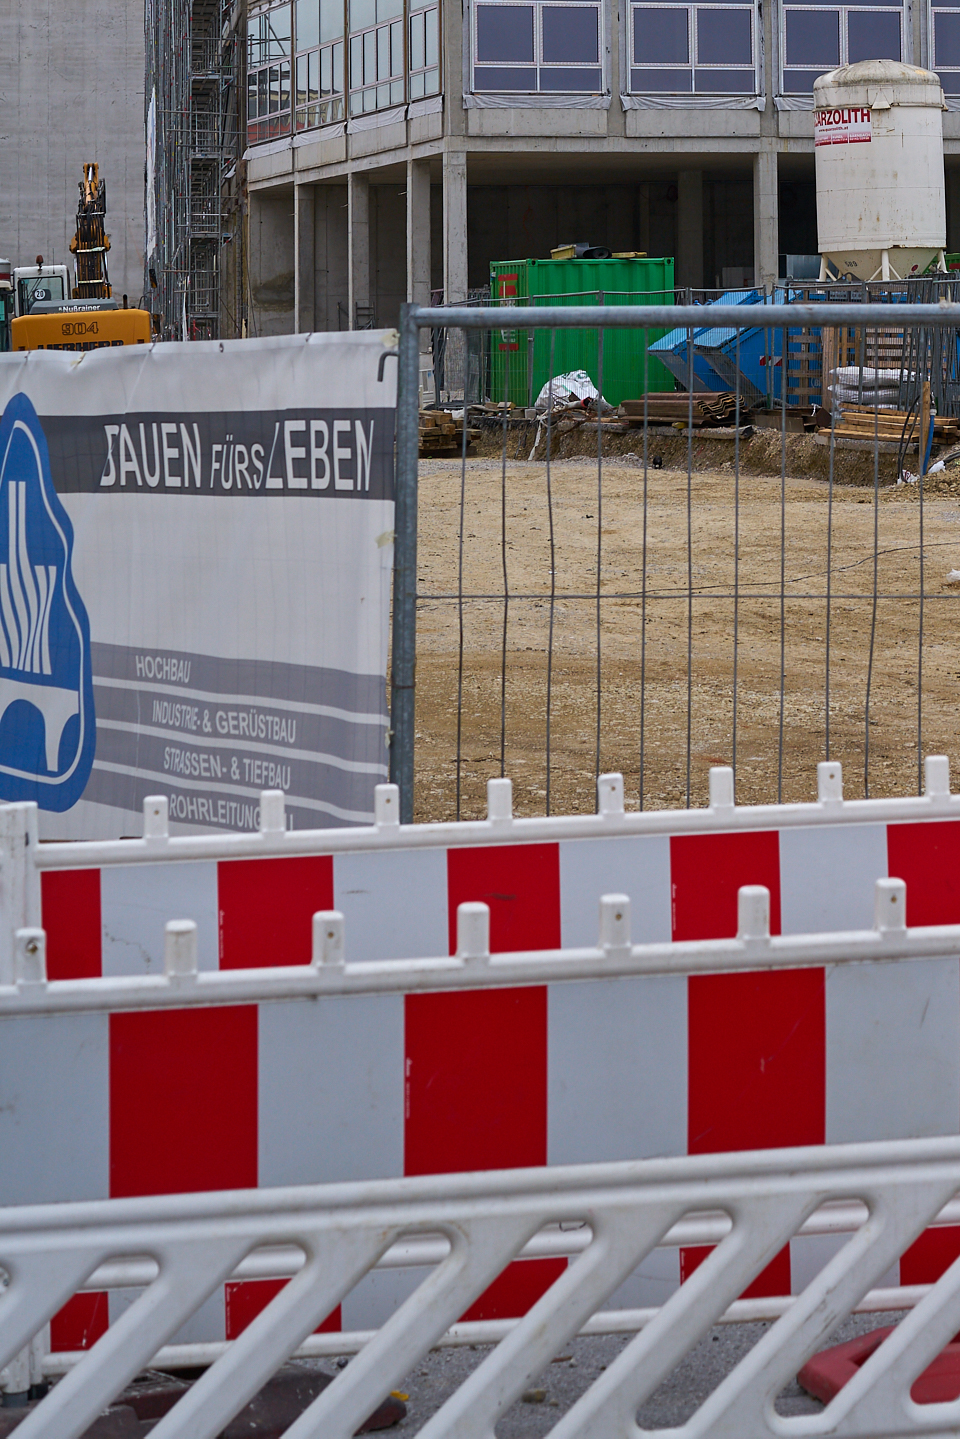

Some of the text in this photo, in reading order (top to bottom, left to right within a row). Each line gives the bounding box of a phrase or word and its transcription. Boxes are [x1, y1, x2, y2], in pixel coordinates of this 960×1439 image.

[62, 304, 101, 313] Nußrainer
[62, 322, 99, 335] 904
[100, 419, 375, 491] BAUEN FÜRS LEBEN
[135, 655, 191, 683] HOCHBAU
[152, 700, 296, 744] INDUSTRIE- & GERÜSTBAU
[163, 746, 291, 790] STRASSEN- & TIEFBAU
